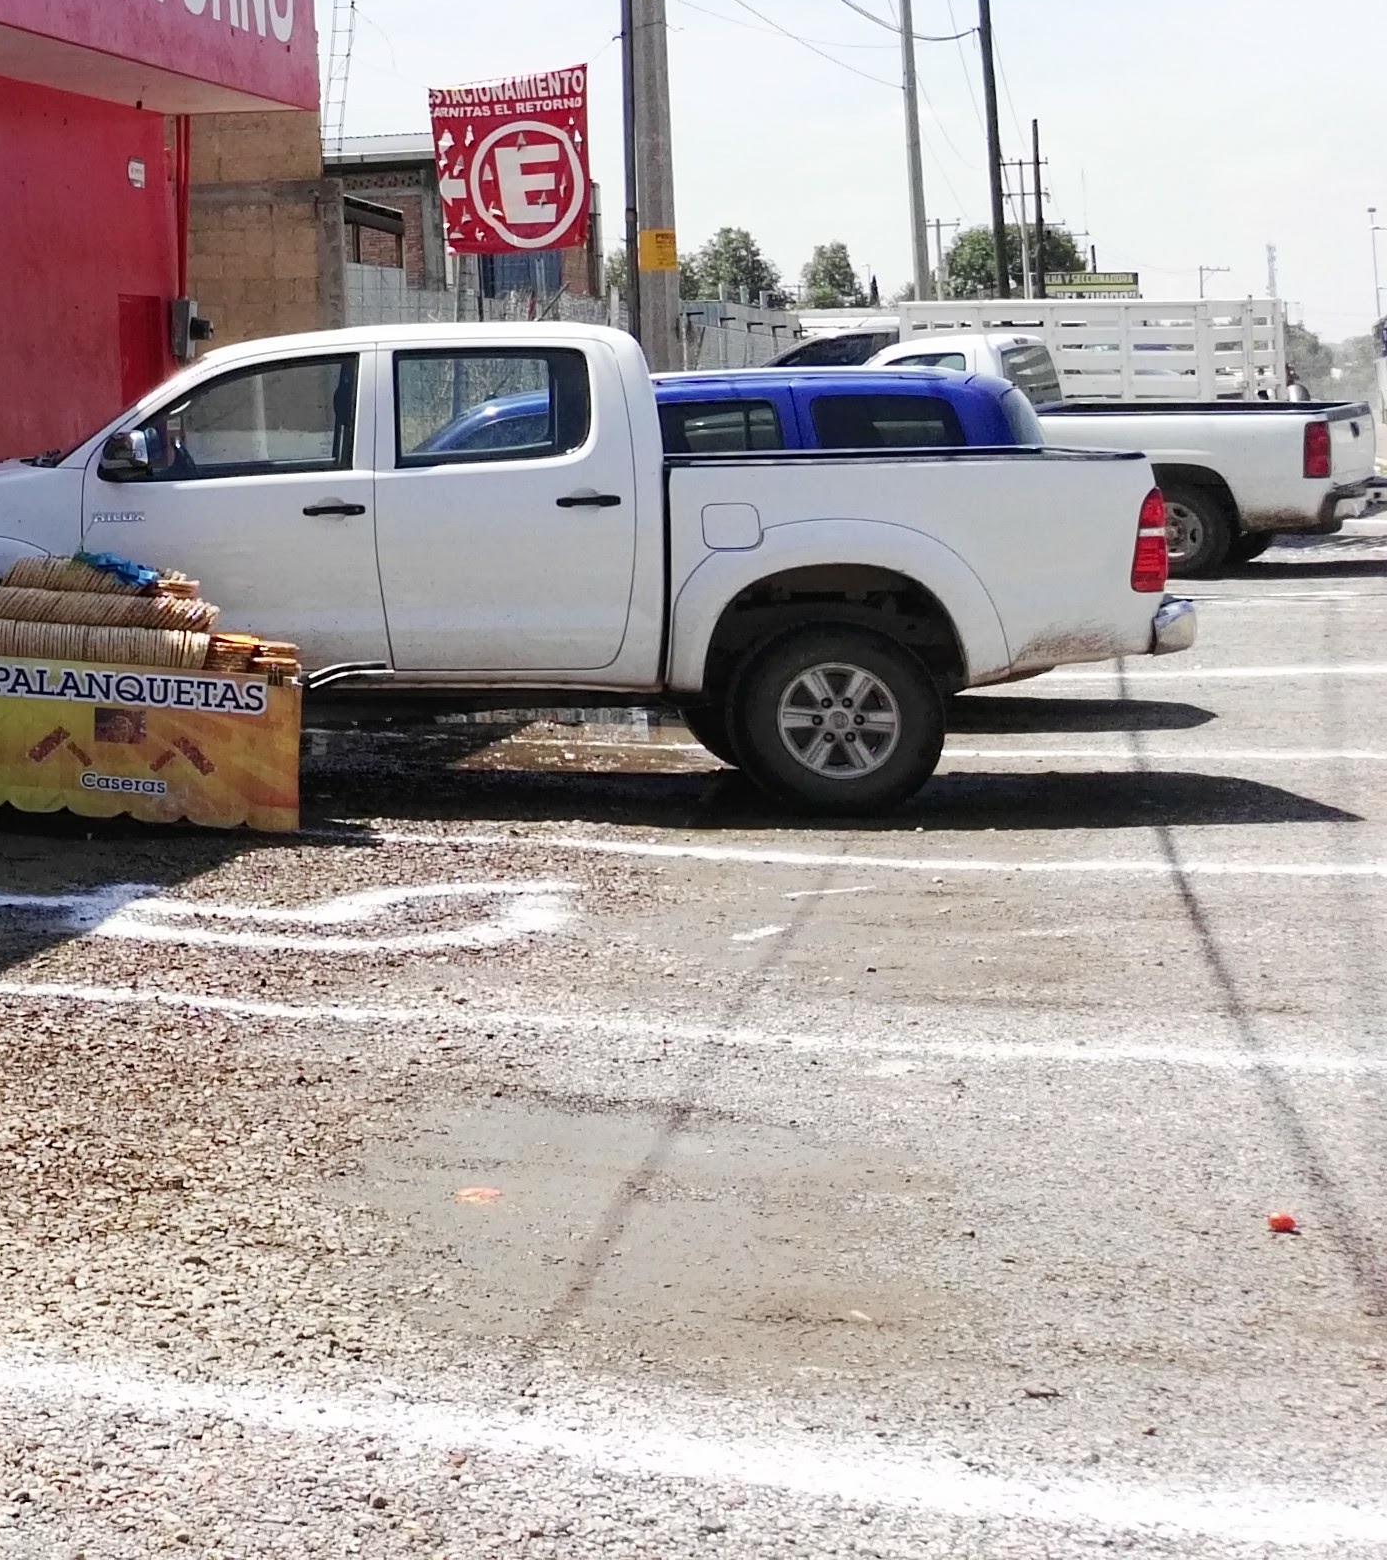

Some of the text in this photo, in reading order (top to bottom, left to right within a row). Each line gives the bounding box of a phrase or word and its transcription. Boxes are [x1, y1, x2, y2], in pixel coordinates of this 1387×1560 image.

[494, 104, 512, 116] EL
[516, 96, 583, 114] RETORNO
[494, 142, 560, 224] E
[93, 511, 146, 523] HILUX
[81, 772, 166, 794] Caseras
